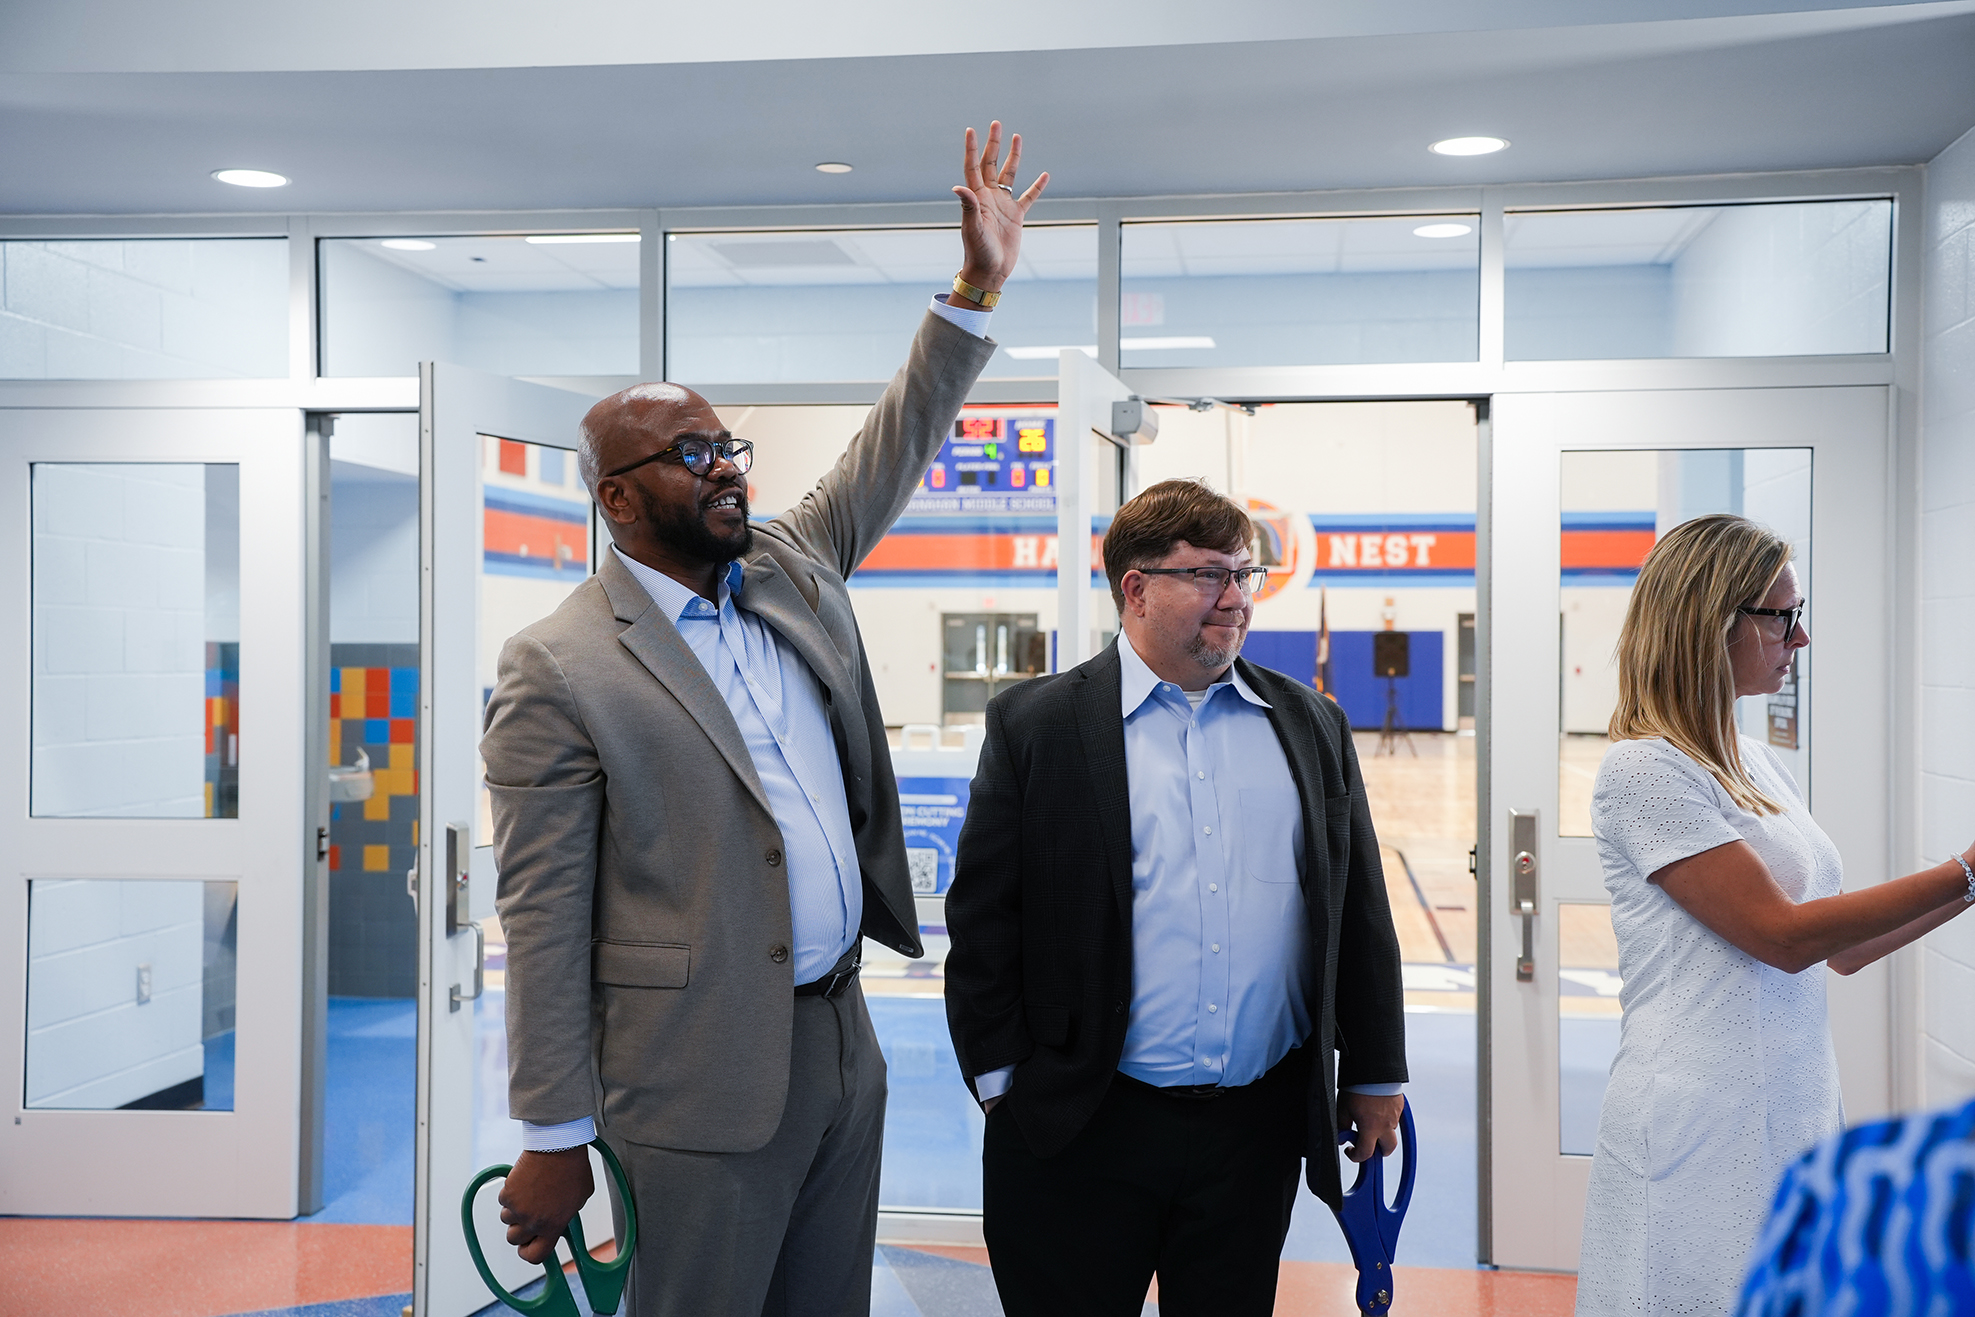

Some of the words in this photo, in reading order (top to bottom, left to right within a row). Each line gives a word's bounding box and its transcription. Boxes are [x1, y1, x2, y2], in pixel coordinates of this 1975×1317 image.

[1018, 428, 1047, 452] 26
[1009, 498, 1055, 511] SCHOOL
[1328, 533, 1437, 567] NEST
[917, 806, 965, 818] CUTTING
